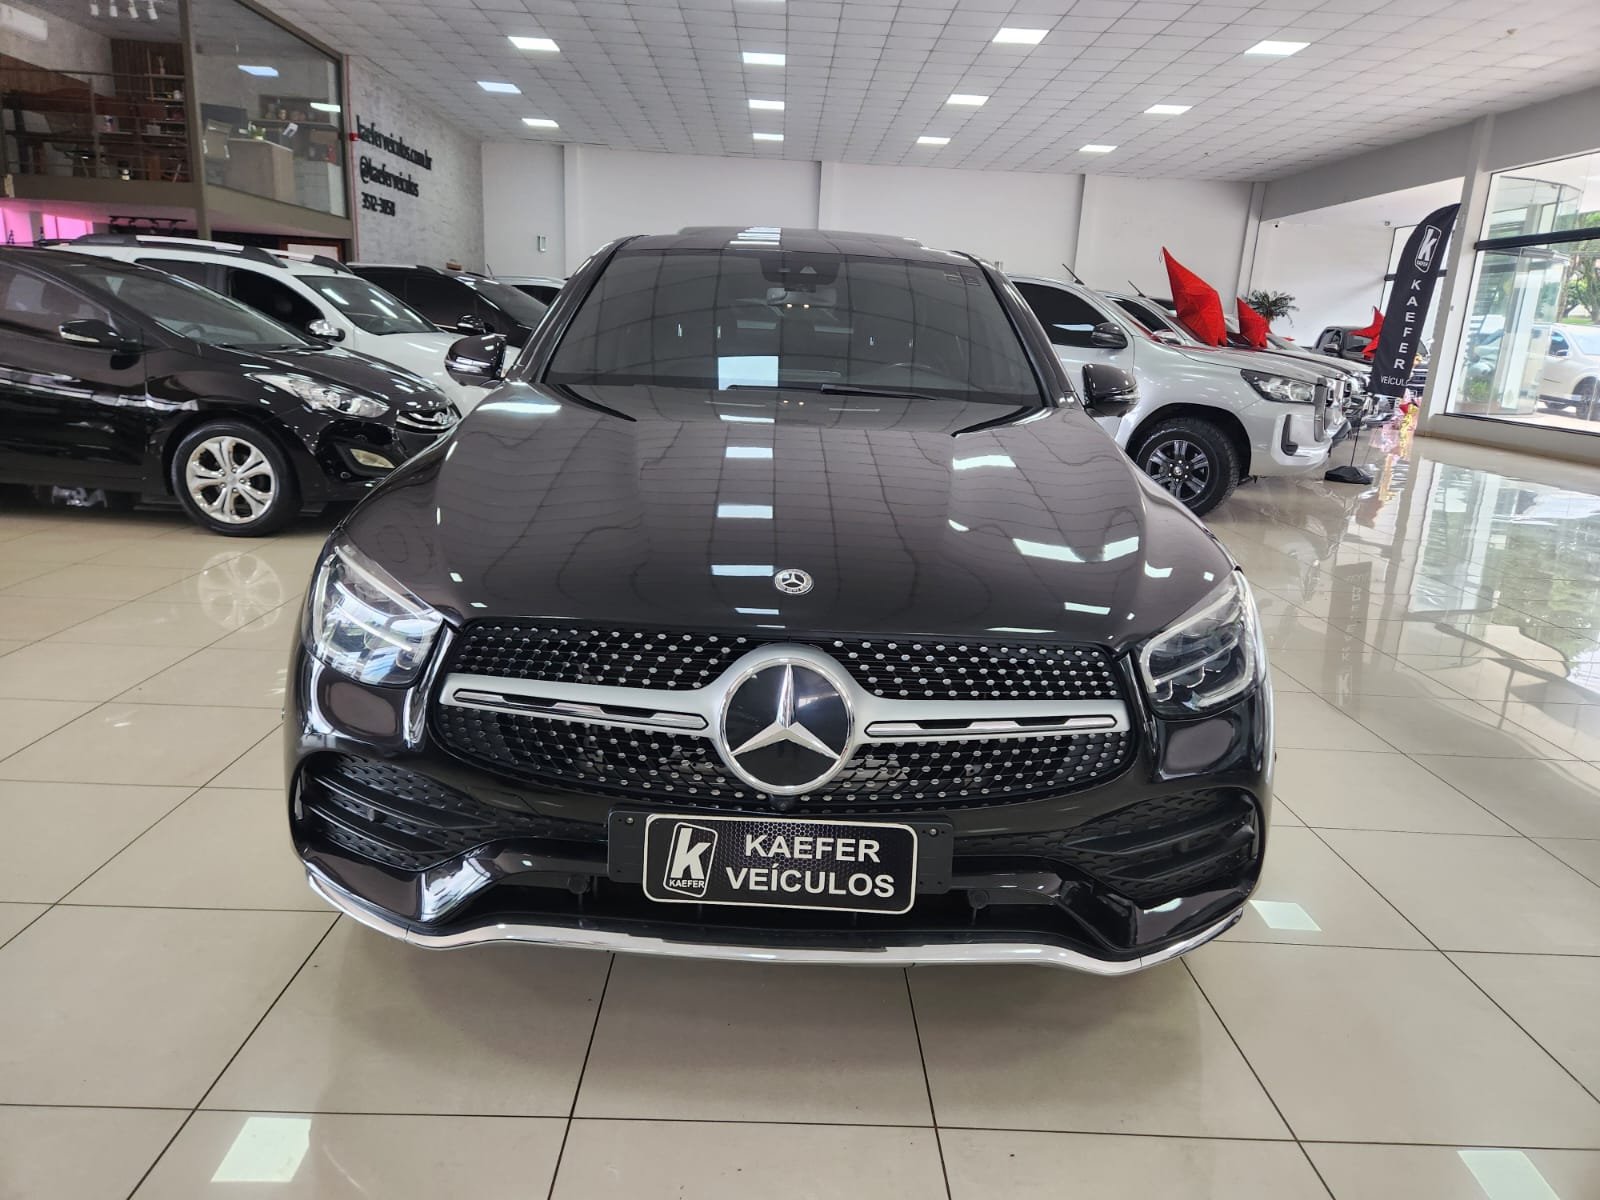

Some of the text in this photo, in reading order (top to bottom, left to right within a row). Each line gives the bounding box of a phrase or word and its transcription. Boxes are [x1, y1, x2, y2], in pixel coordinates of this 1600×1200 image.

[1393, 279, 1421, 369] KAEFER
[744, 834, 881, 863] KAEFER
[669, 879, 706, 889] KAEFER
[725, 863, 895, 898] VEÍCULOS
